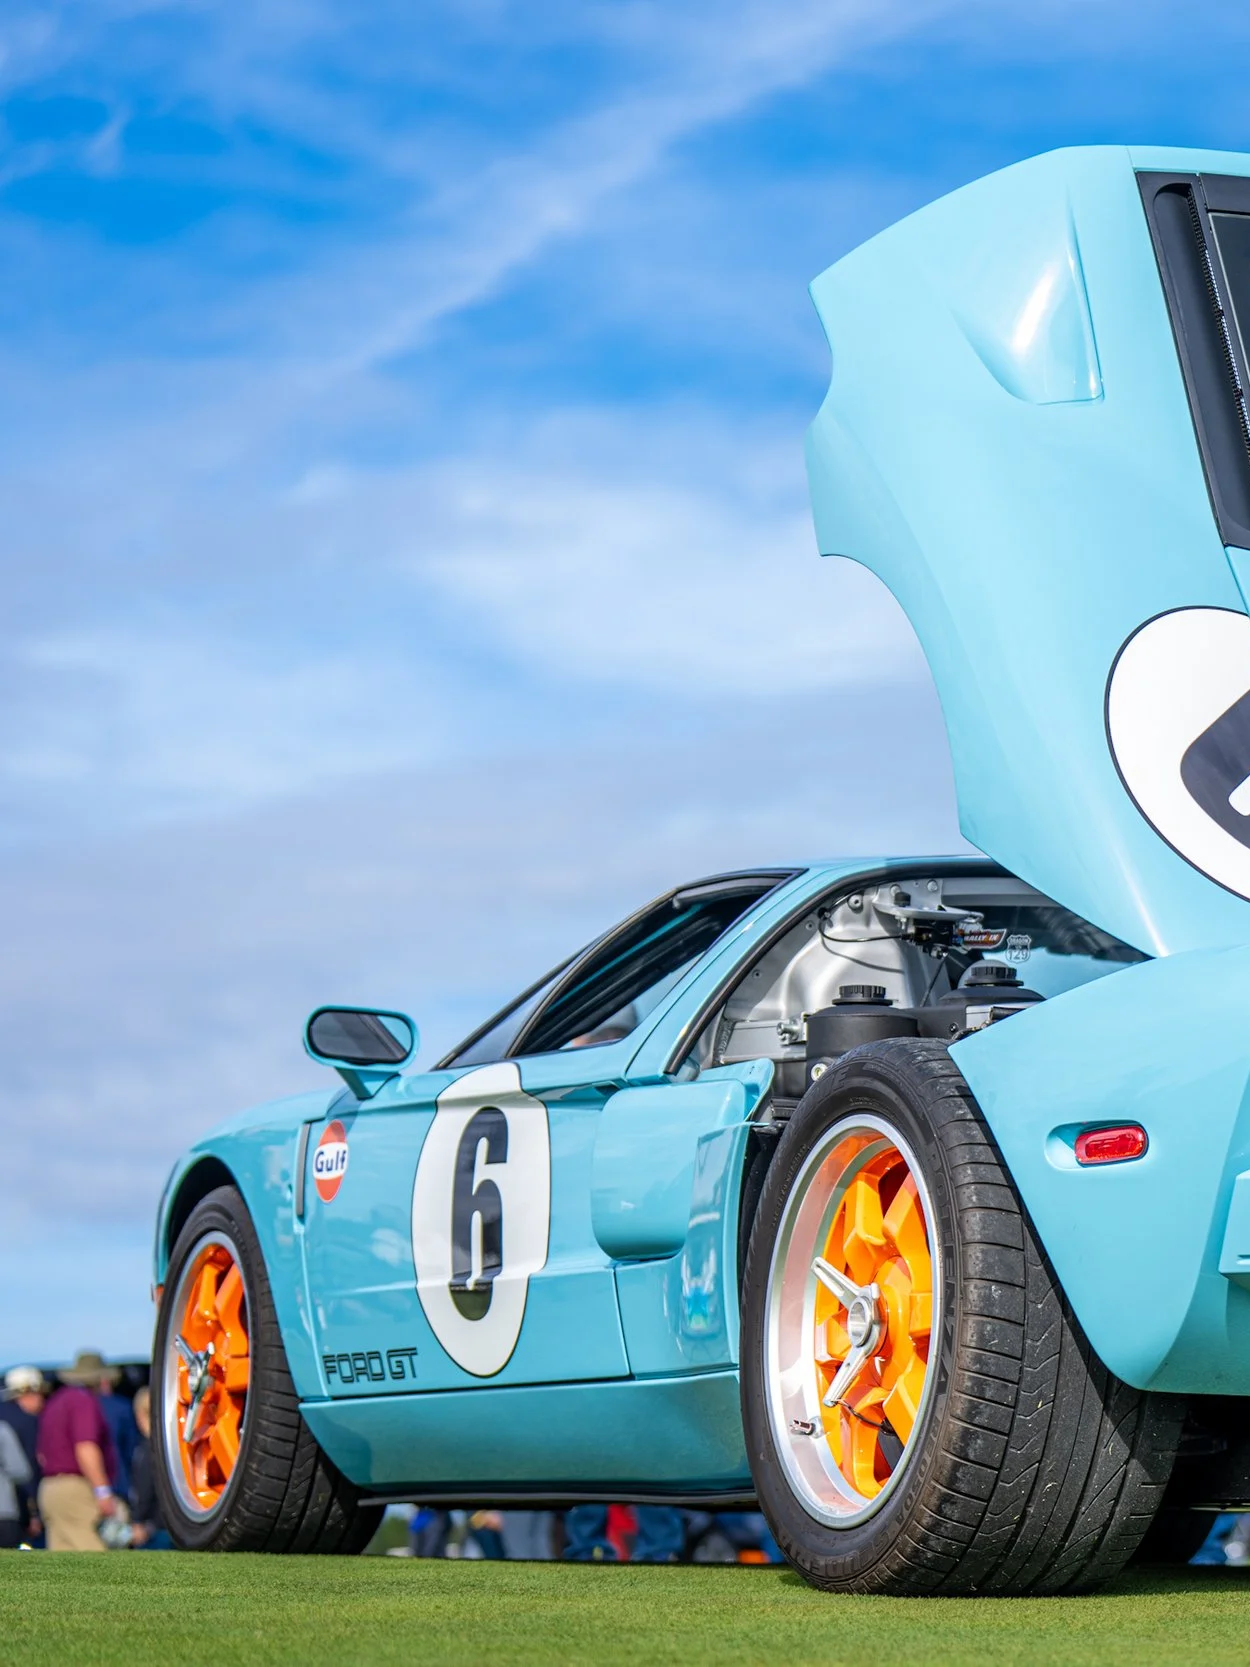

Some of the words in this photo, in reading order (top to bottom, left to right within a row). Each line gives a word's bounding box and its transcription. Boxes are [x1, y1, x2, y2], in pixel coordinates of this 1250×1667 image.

[1008, 949, 1028, 960] 129
[314, 1148, 348, 1173] Gulf
[448, 1105, 509, 1321] 6
[322, 1350, 385, 1385] FORD
[386, 1346, 418, 1380] GT
